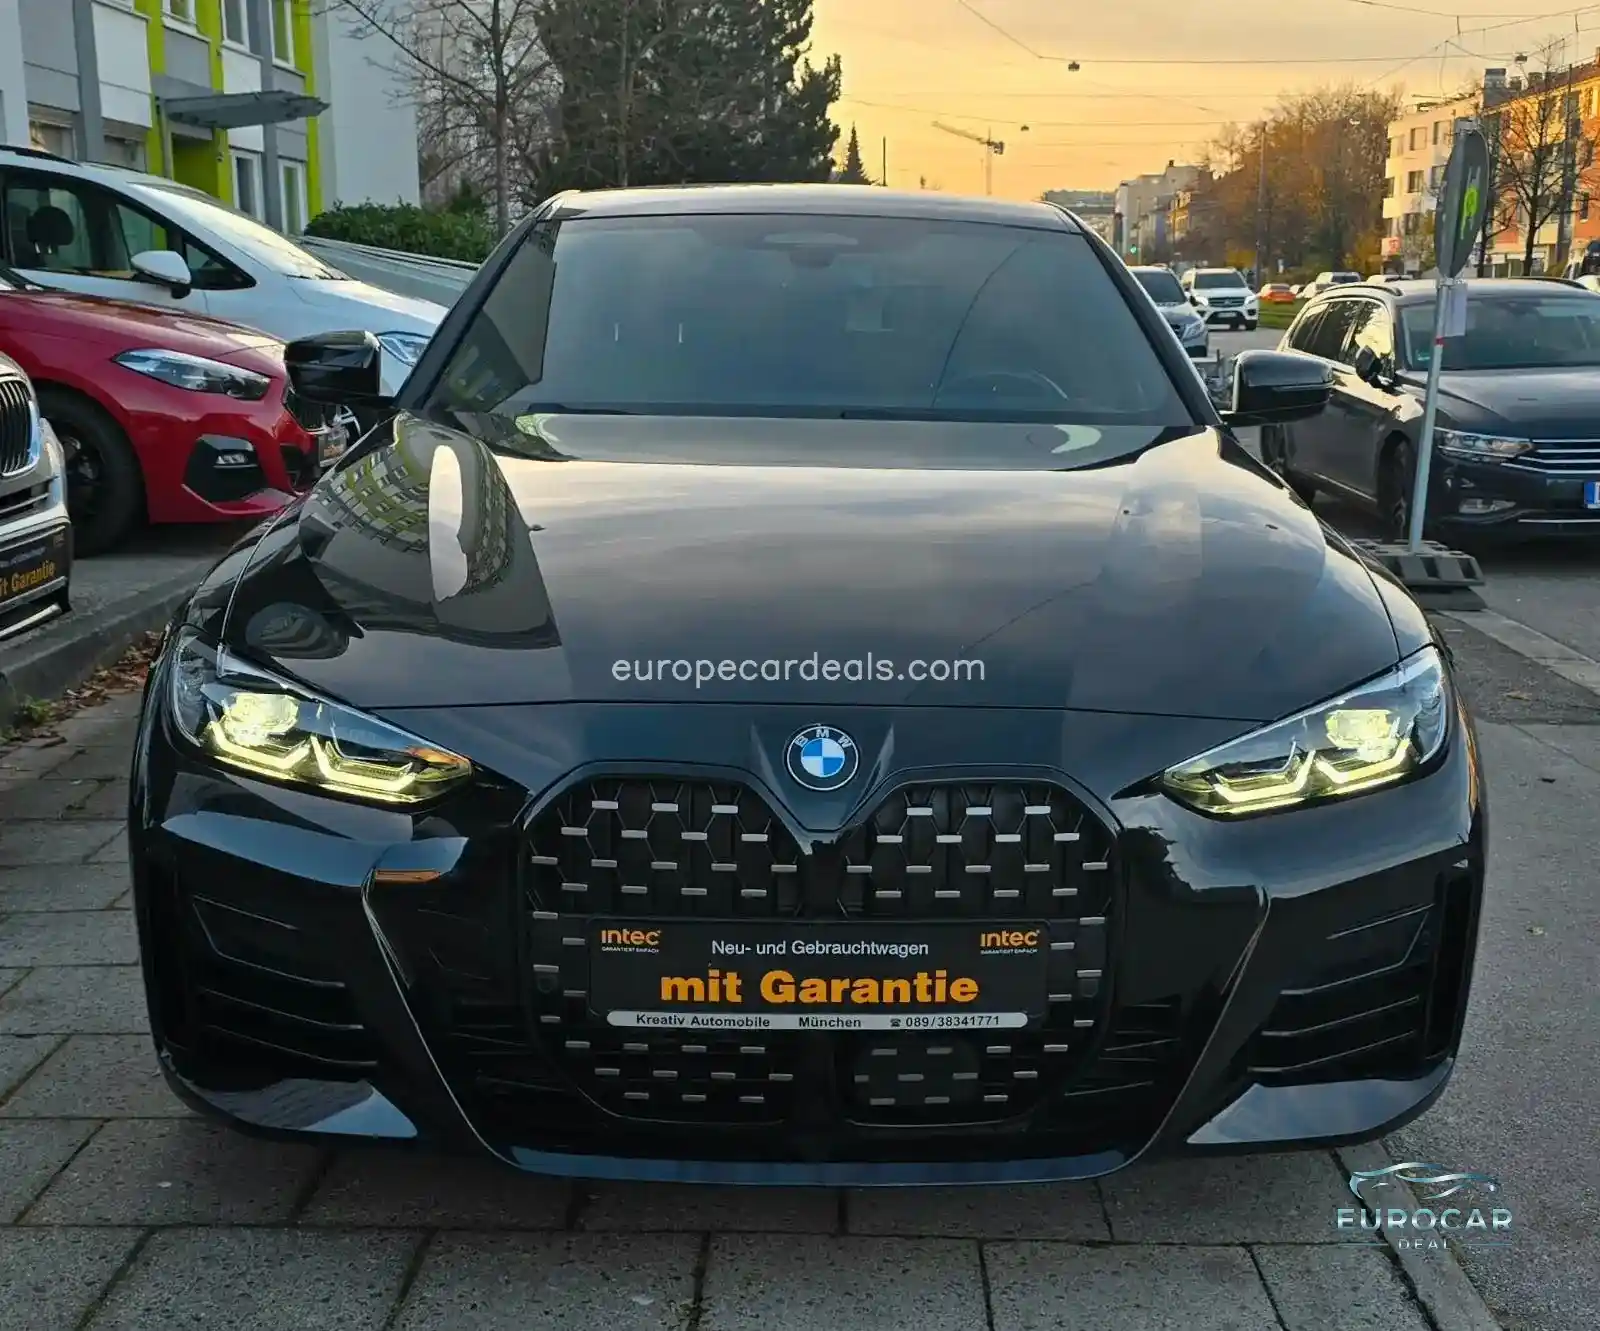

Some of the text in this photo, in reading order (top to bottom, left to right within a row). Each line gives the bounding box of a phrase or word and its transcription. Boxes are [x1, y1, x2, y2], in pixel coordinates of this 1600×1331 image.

[794, 727, 853, 749] BMW
[711, 940, 929, 958] Neu- und Gebrauchtwagen
[660, 969, 979, 1004] mit Garantie
[636, 1013, 1000, 1028] Kreativ Automobile München 089/38341771
